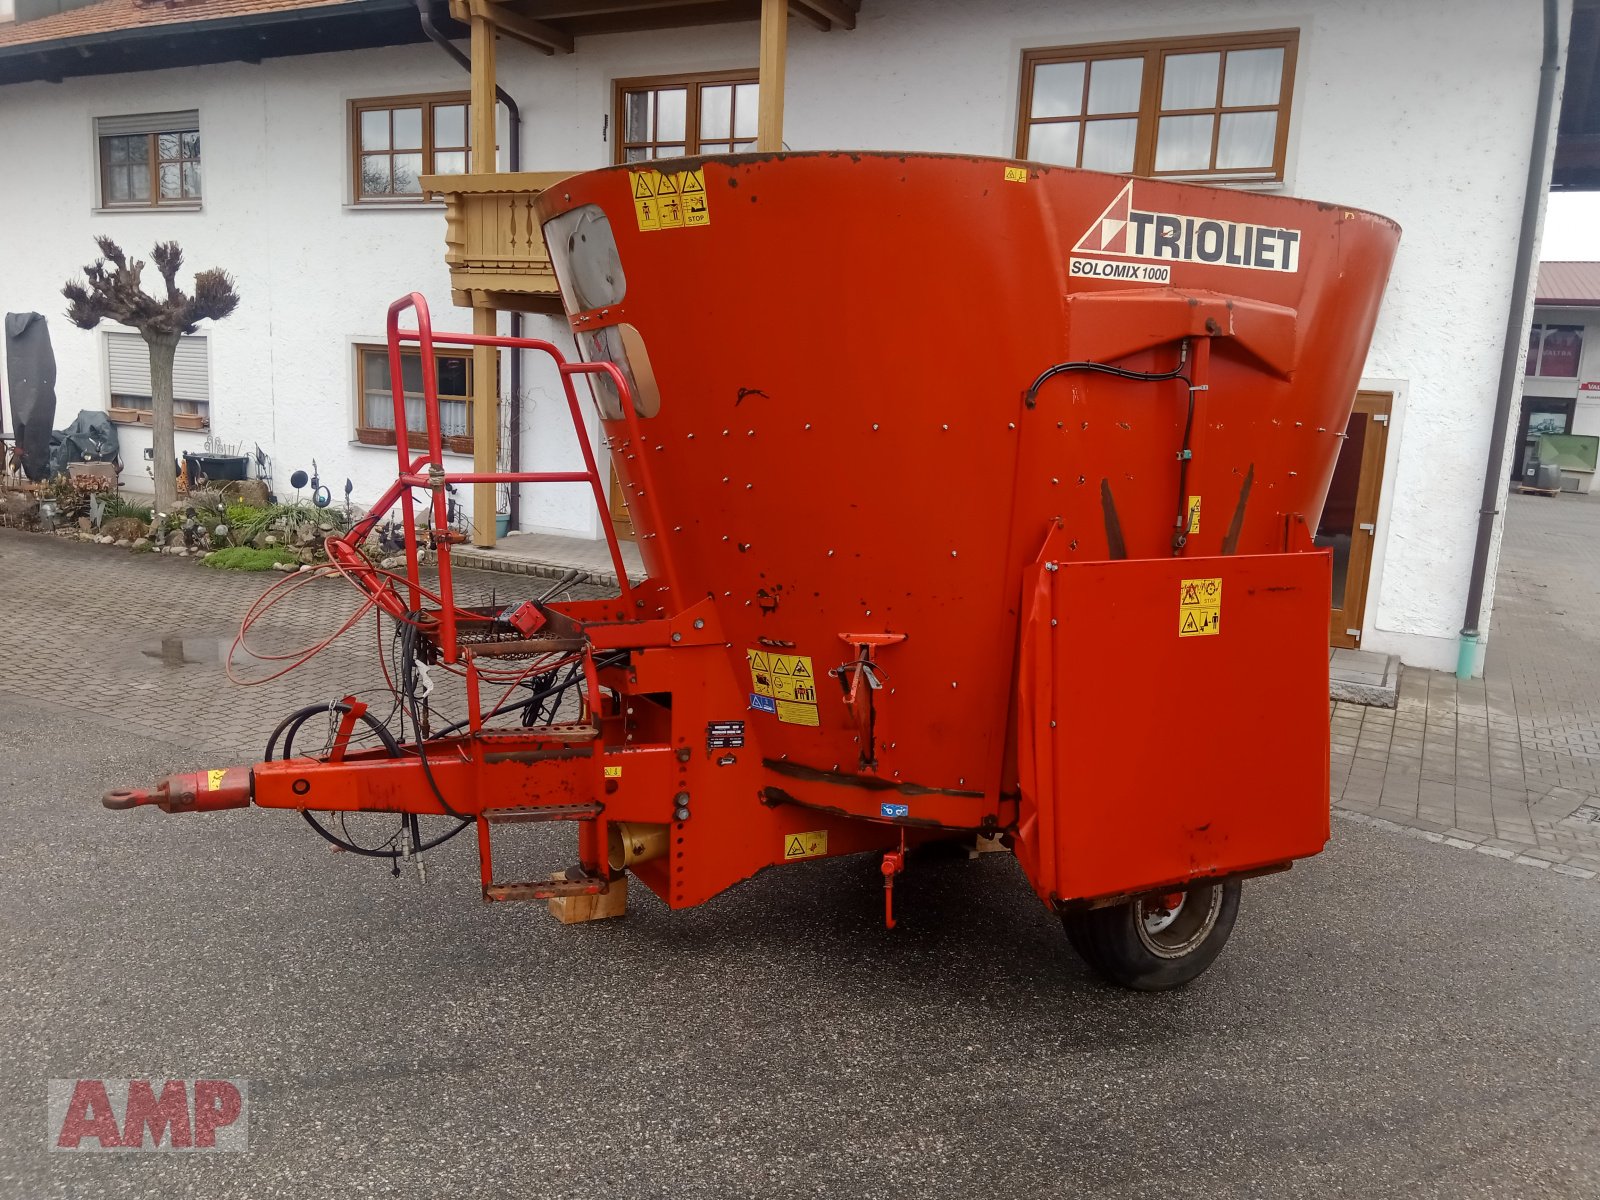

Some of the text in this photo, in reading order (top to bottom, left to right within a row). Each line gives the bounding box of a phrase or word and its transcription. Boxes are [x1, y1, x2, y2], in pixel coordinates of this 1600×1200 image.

[1130, 212, 1298, 269] TRIOLIET
[1071, 261, 1168, 281] SOLOMIX 1000
